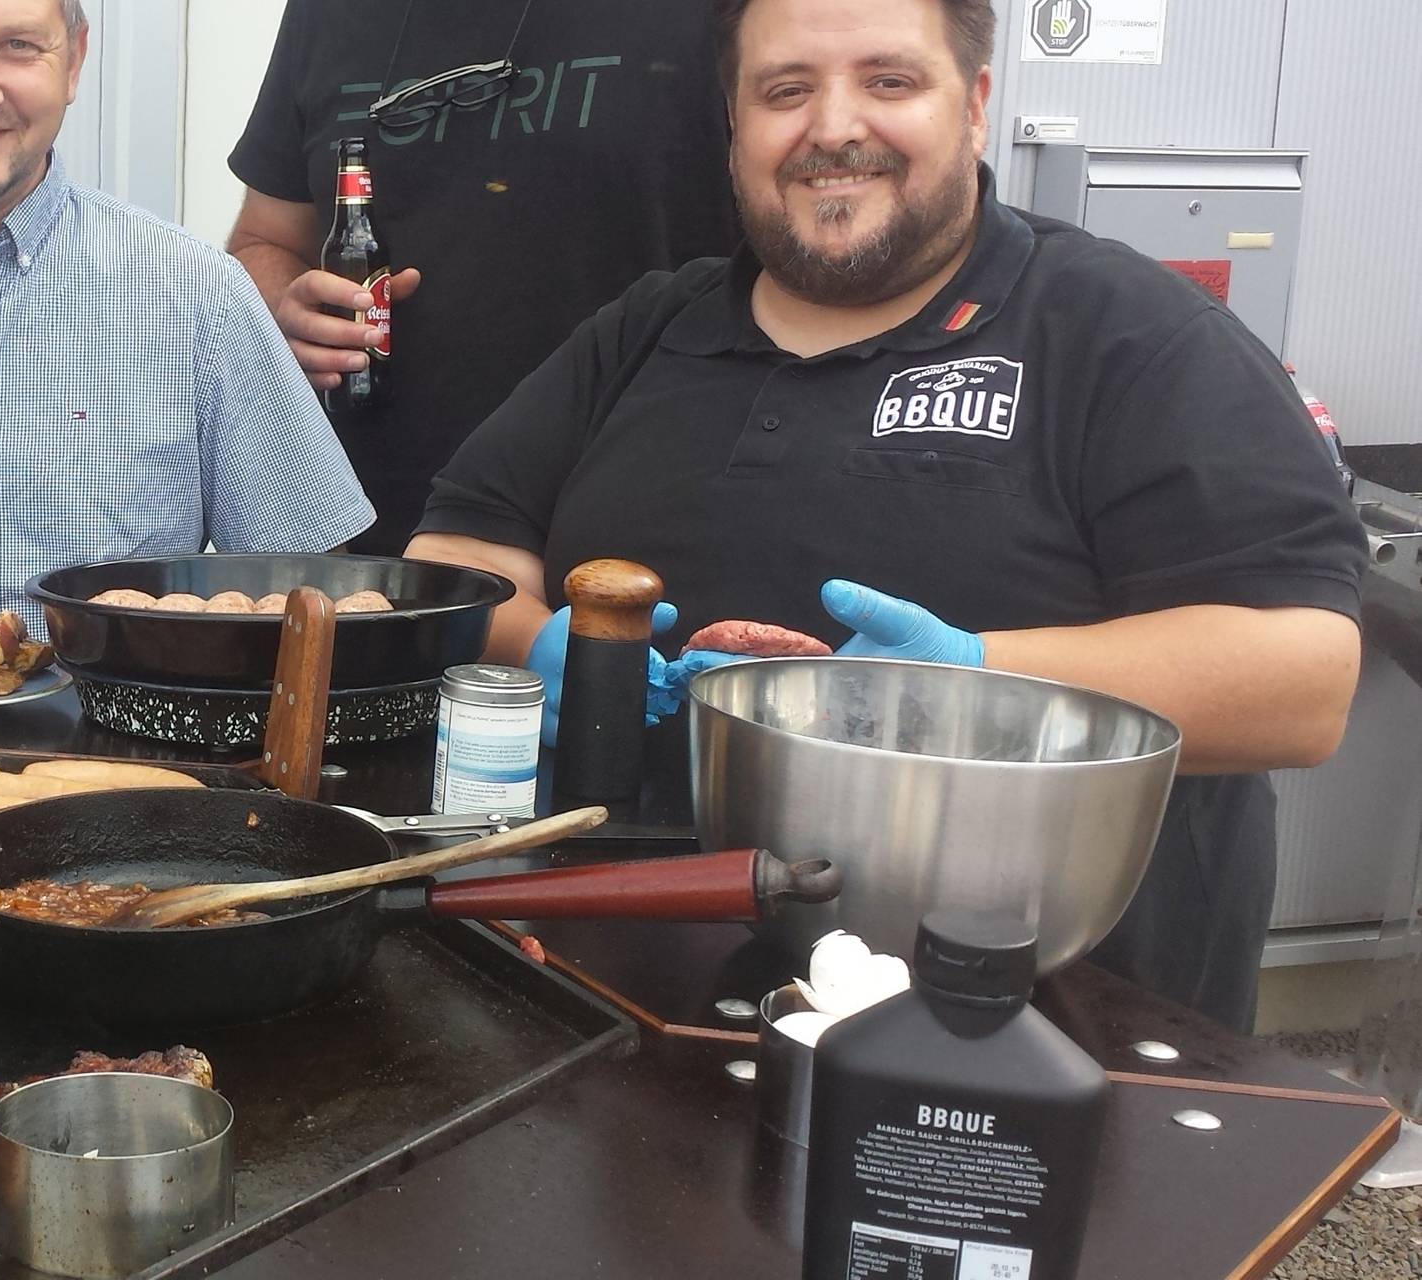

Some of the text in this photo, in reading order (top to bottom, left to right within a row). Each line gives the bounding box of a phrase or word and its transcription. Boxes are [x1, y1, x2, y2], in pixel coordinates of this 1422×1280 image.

[1051, 38, 1068, 46] STOP
[951, 361, 998, 374] BAVARIAN
[878, 390, 1014, 433] BBQUE
[917, 1104, 996, 1135] BBQUE
[876, 1123, 916, 1137] BARBECUE
[918, 1131, 942, 1141] SAUCE
[918, 1158, 935, 1166] SENF
